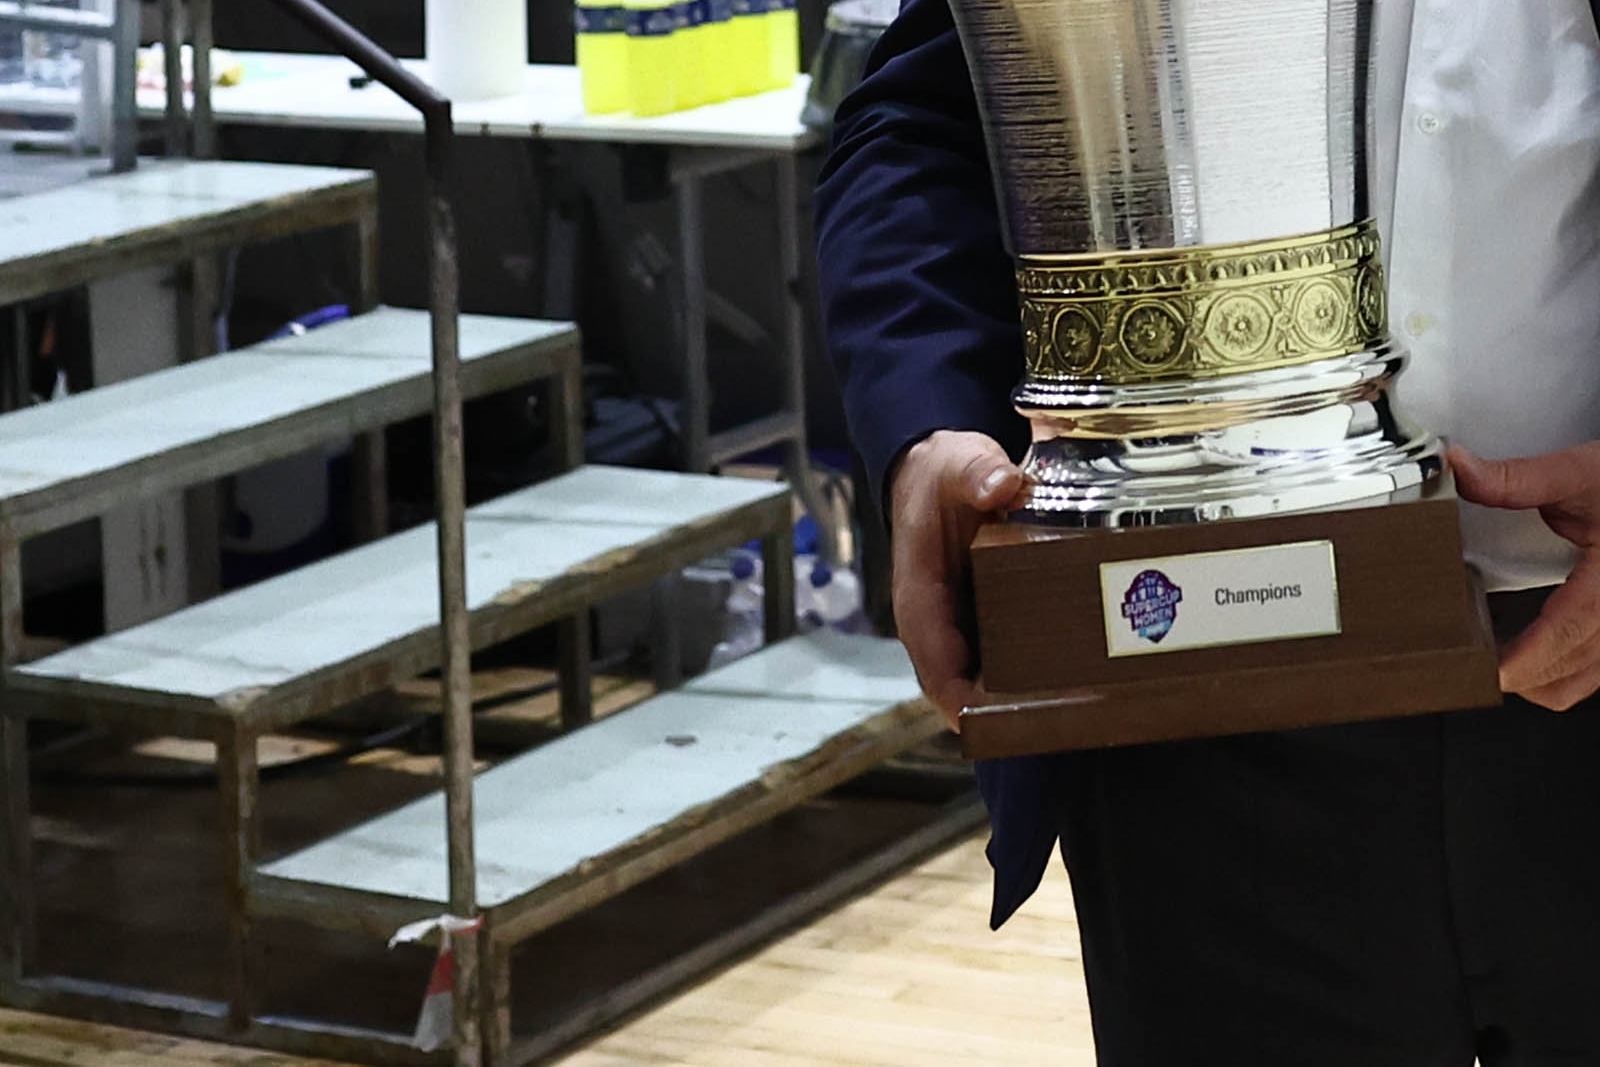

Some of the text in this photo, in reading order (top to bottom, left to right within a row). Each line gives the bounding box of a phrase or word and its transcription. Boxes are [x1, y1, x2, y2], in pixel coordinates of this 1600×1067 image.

[1124, 589, 1180, 616] SUPERCUP
[1215, 583, 1302, 605] Champions
[1134, 608, 1173, 628] WOMEN
